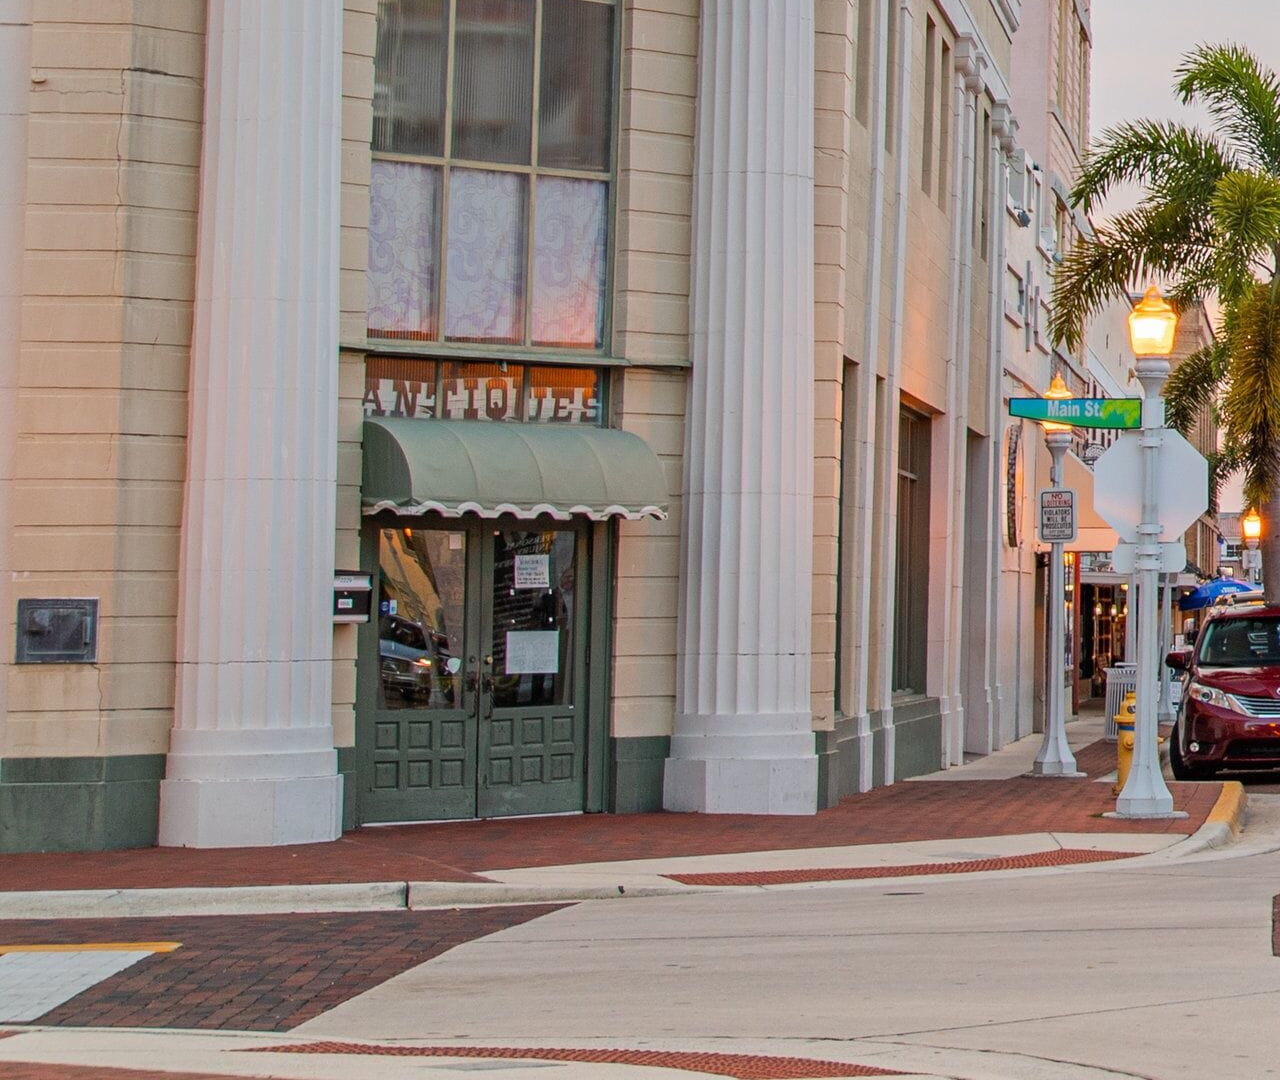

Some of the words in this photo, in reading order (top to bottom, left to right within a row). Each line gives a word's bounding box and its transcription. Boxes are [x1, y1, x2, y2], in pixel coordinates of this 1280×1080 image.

[1047, 400, 1080, 417] Main
[1084, 400, 1104, 417] St.
[1044, 508, 1071, 516] VIOLATORS
